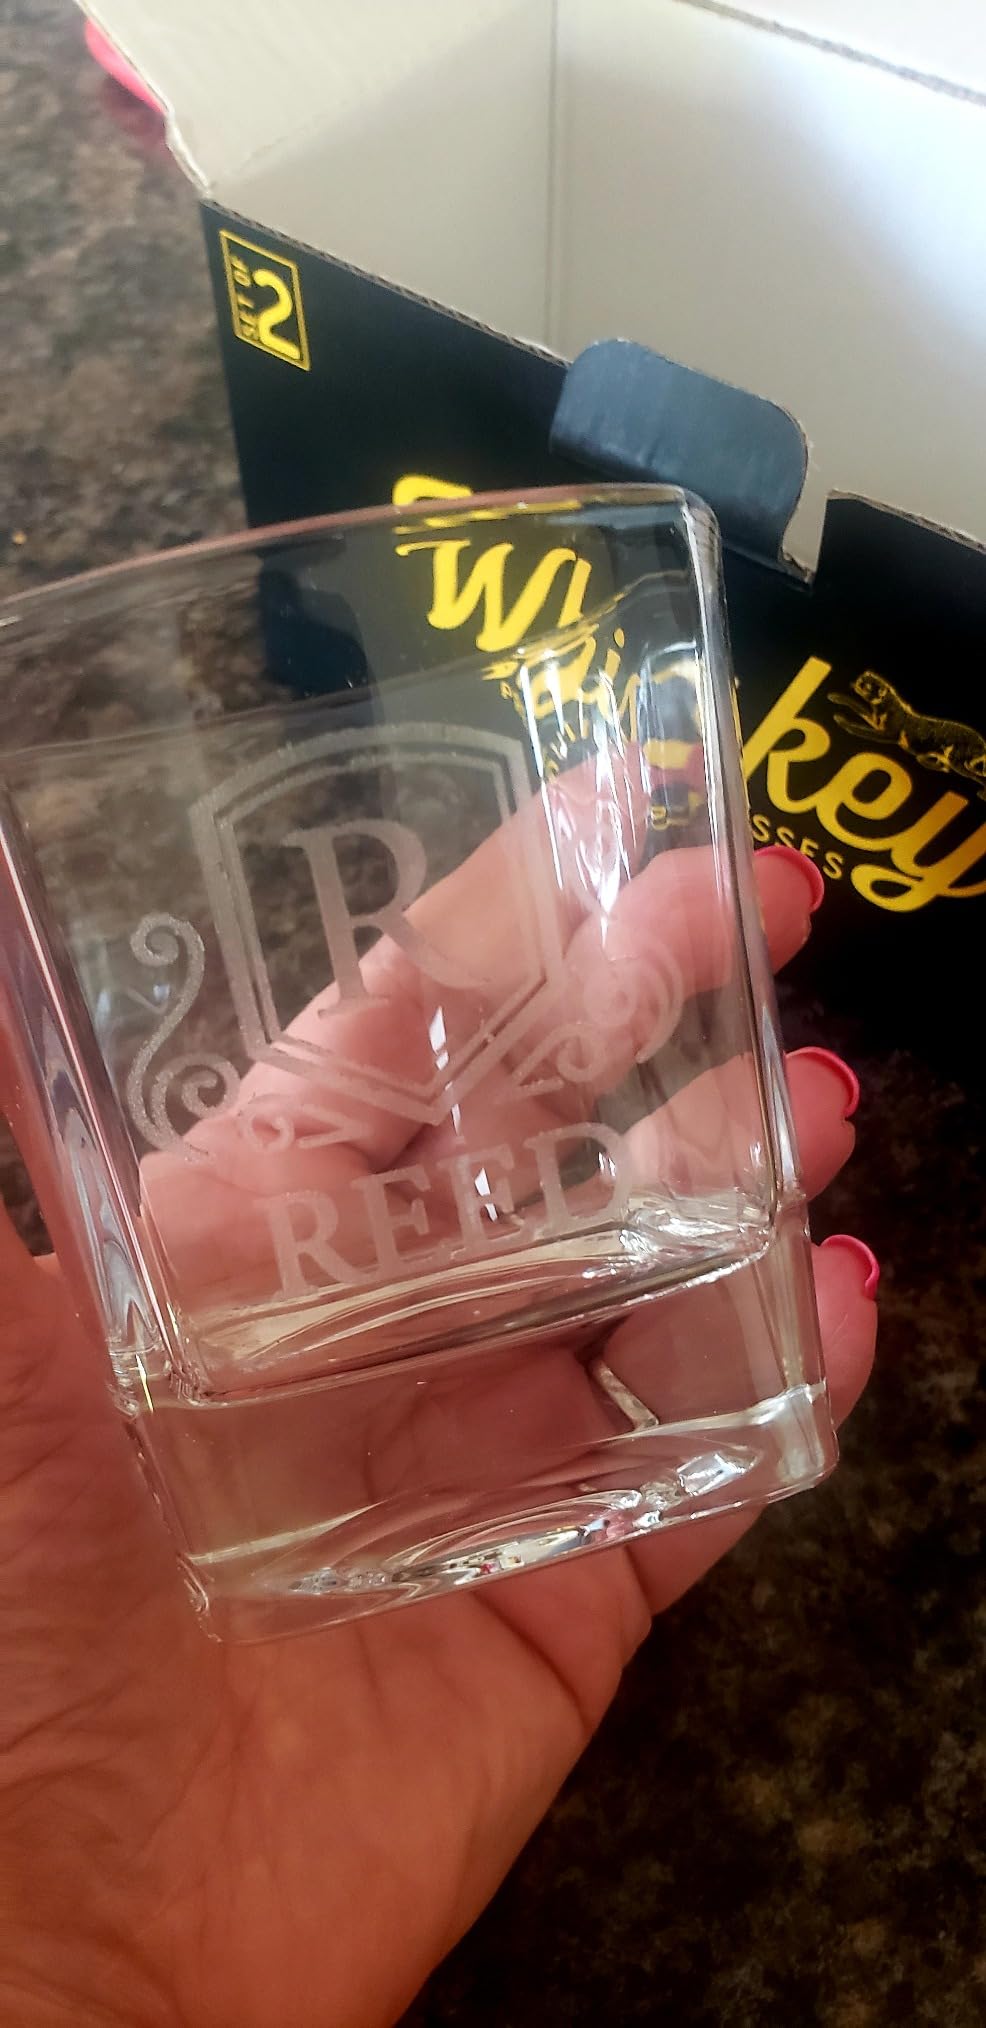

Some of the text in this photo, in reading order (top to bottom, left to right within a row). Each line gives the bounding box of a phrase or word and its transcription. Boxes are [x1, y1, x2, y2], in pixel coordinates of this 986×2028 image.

[230, 255, 251, 288] OF
[252, 268, 301, 360] 2
[279, 817, 498, 1019] R
[262, 1120, 640, 1303] REED
